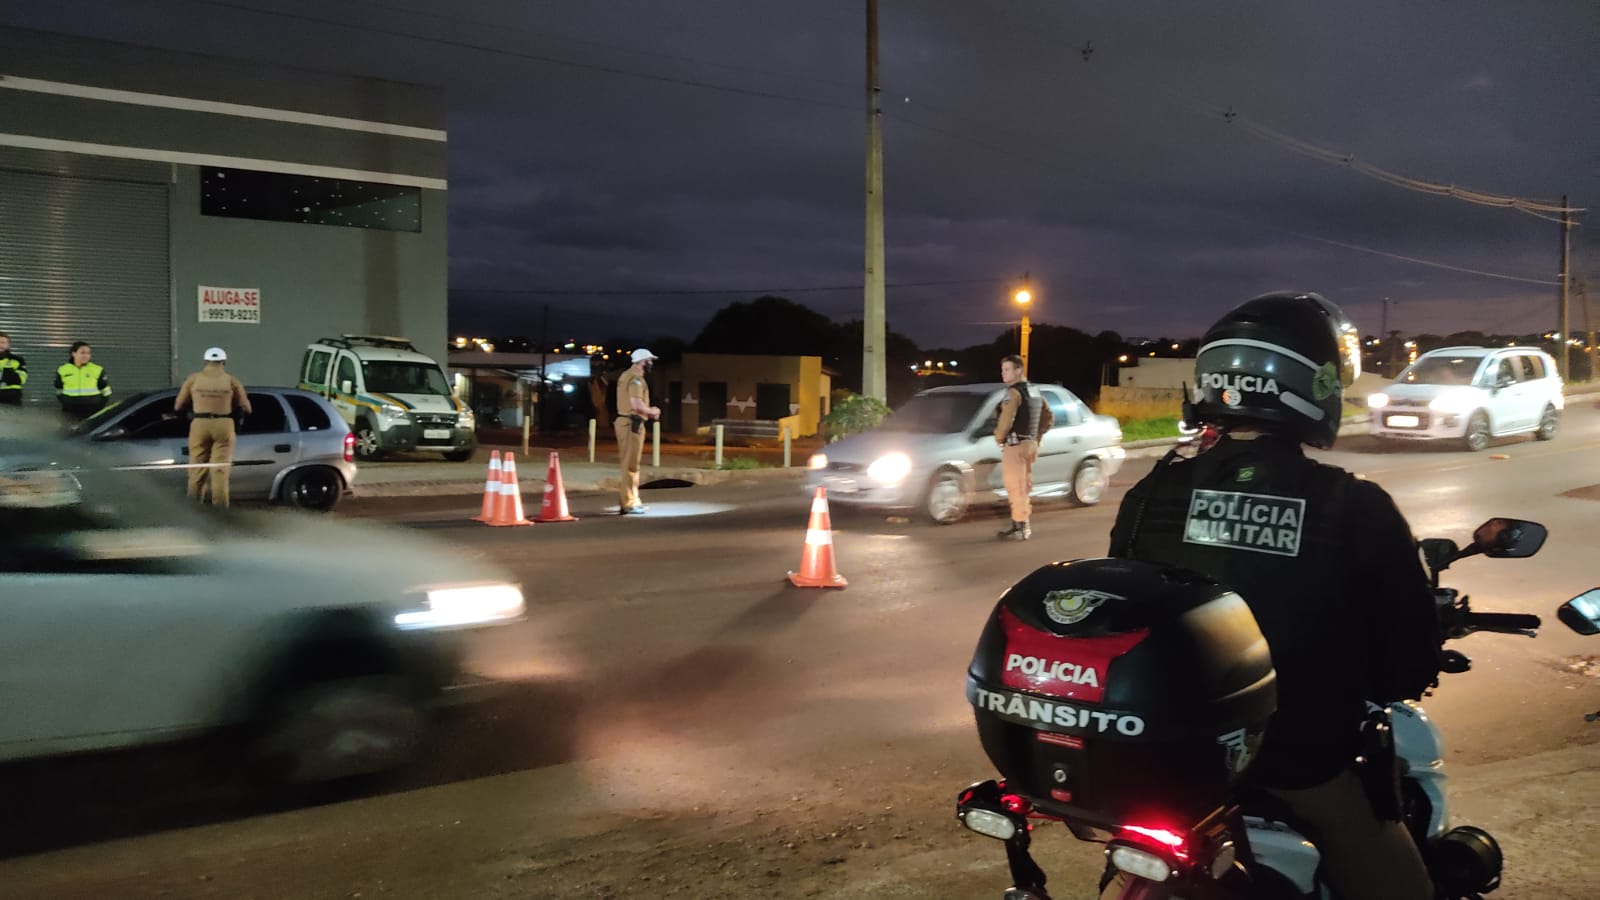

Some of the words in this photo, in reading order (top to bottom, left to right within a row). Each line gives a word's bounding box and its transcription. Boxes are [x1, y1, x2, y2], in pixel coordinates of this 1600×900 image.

[204, 289, 257, 306] ALUGA-SE
[1201, 373, 1280, 395] POLÍCIA
[1192, 499, 1297, 527] POLÍCIA
[1188, 519, 1297, 550] MILITAR
[1006, 654, 1099, 688] POLÍCIA
[976, 688, 1145, 736] TRÂNSITO
